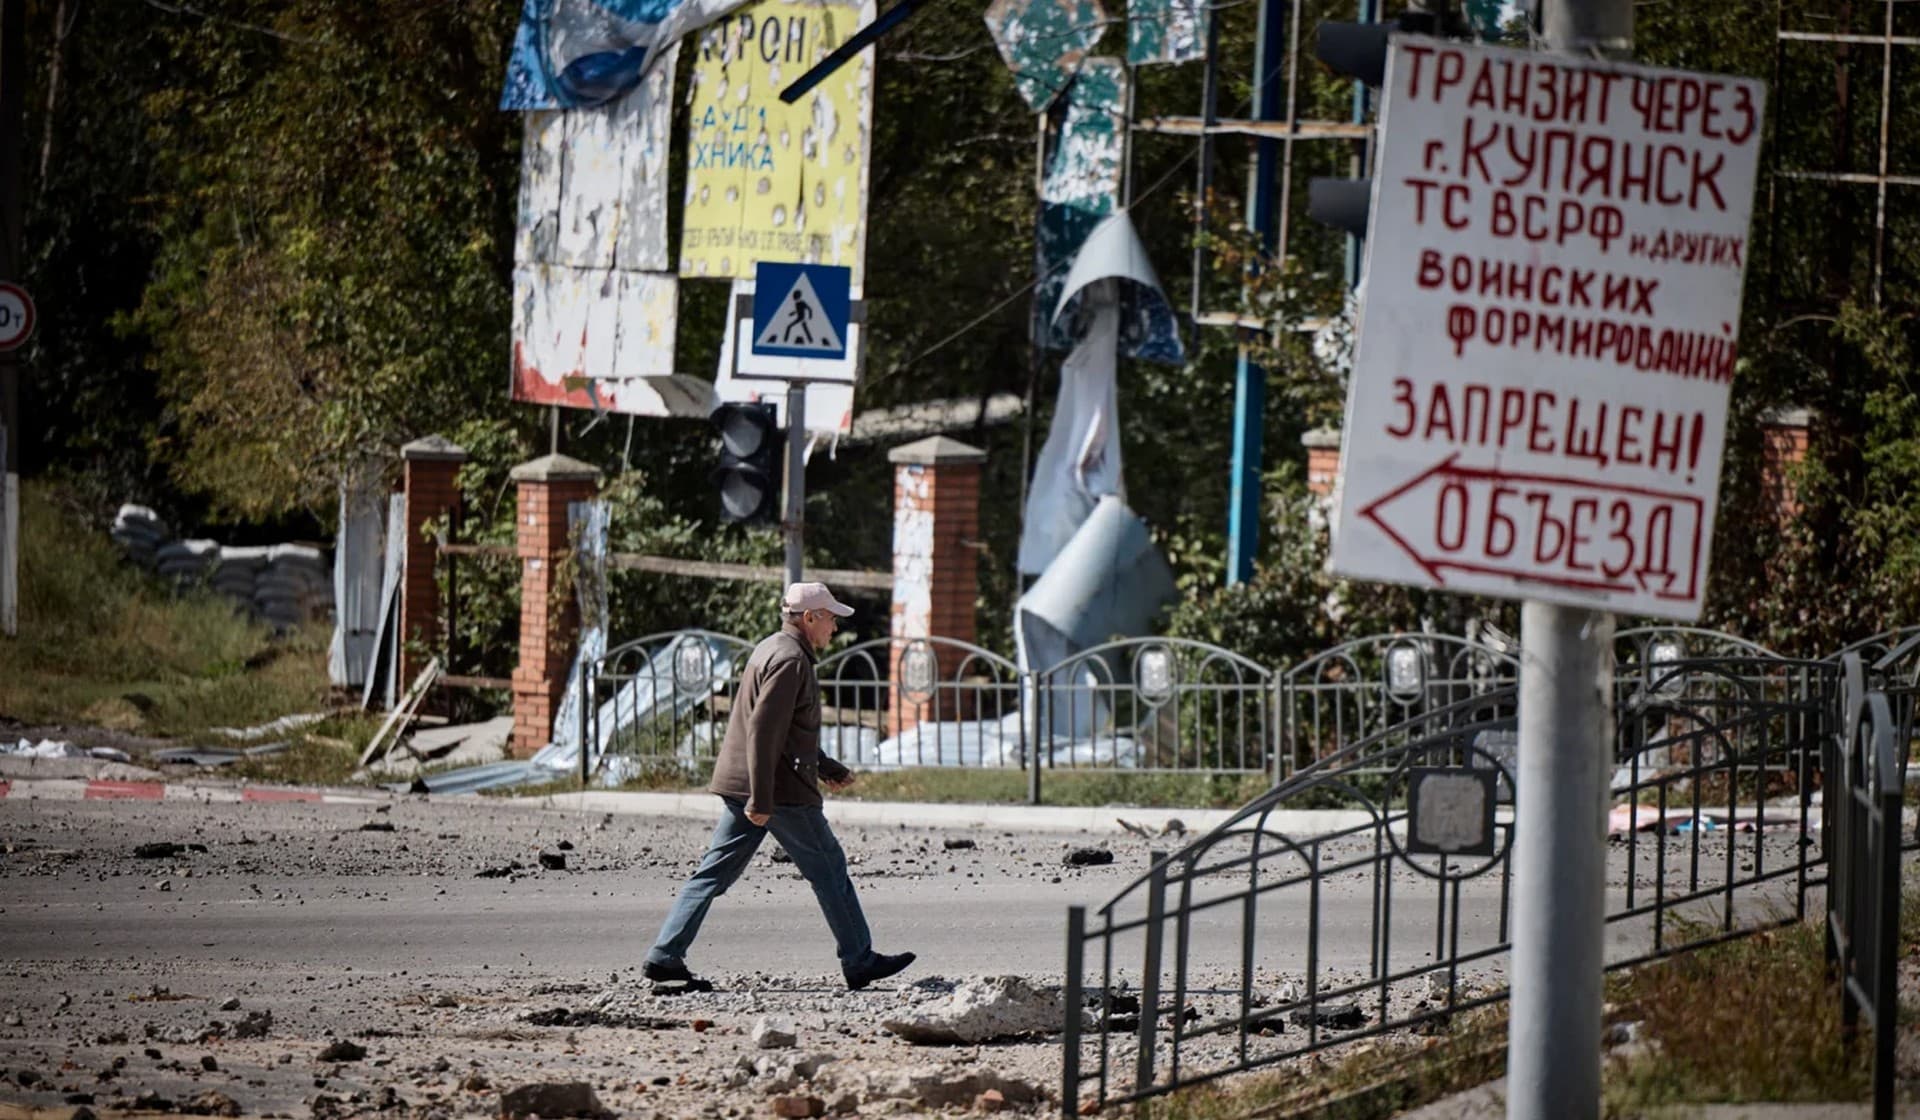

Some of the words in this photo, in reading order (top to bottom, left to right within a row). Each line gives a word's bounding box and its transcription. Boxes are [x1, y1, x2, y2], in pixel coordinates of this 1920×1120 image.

[1403, 45, 1622, 125] ТРАНЗИТ
[1631, 75, 1756, 145] ЧЕРЕЗ
[1460, 117, 1728, 212] КУПЯНСК
[1403, 178, 1470, 231] ТС
[1491, 190, 1625, 252] ВСРФ
[1647, 227, 1745, 268] ДРУГИХ
[1417, 249, 1660, 317] ВОИНСКИХ
[1447, 303, 1737, 385] ФОРМИРОВАНИЙ
[1386, 378, 1704, 484] ЗАПРЕЩЕН!
[1435, 480, 1677, 591] ОБЪЕЗД
